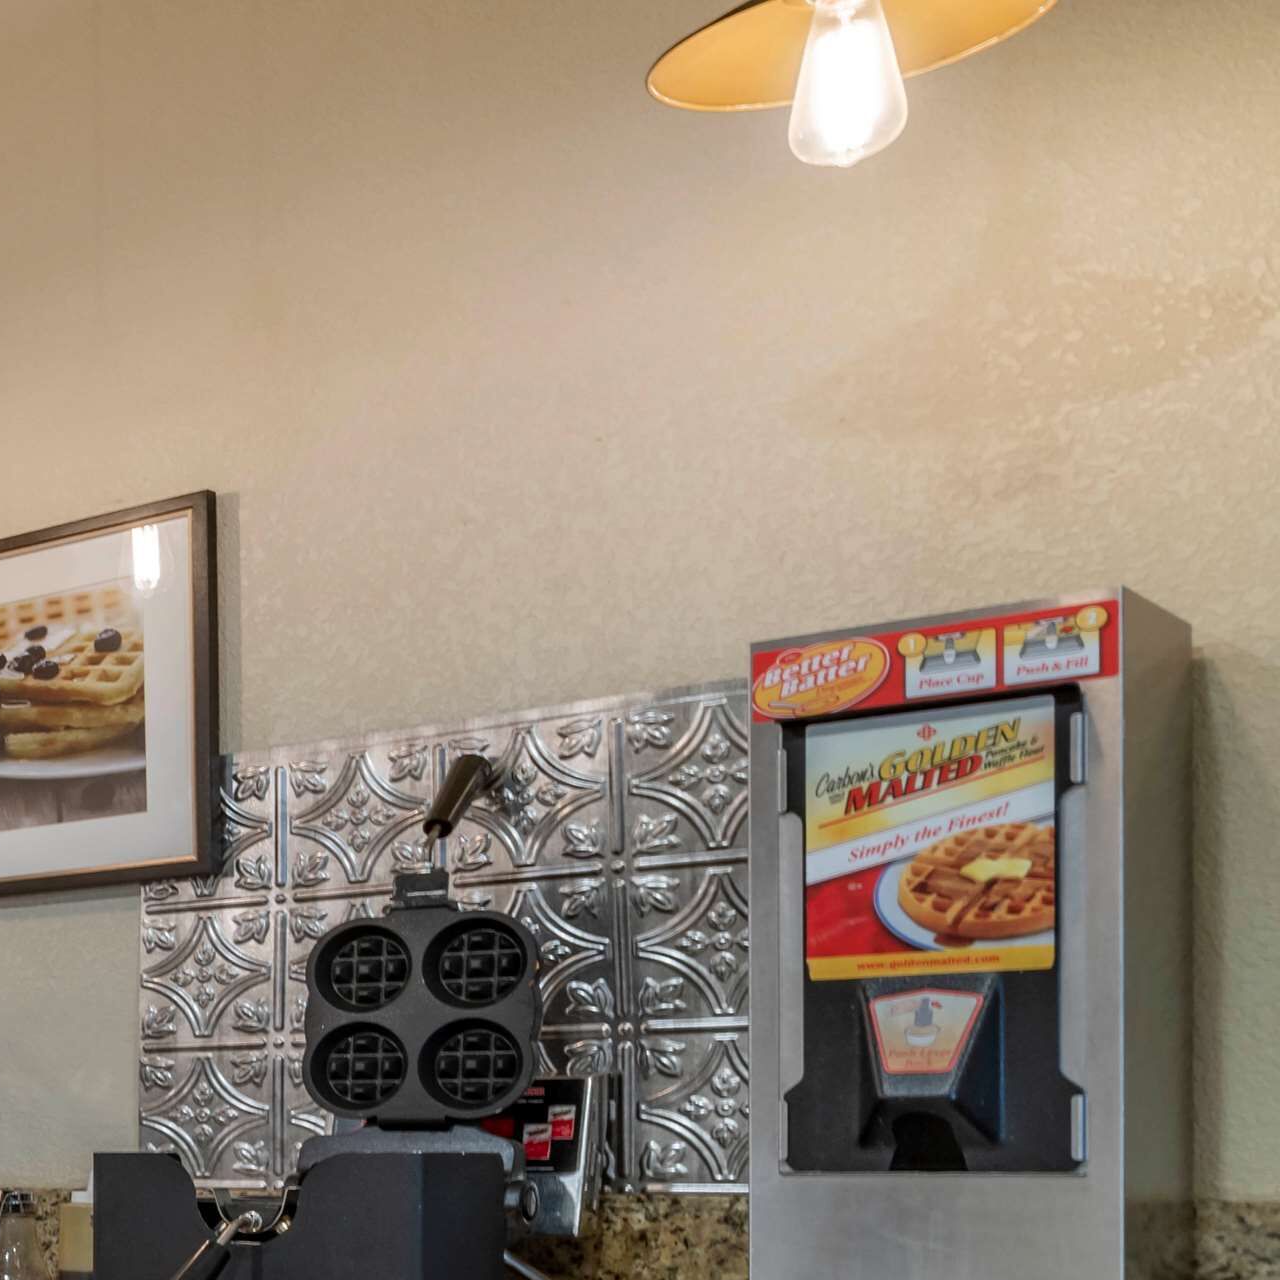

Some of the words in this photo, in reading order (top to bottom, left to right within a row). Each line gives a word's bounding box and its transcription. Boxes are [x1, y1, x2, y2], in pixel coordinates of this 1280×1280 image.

[763, 642, 855, 688] Better
[780, 652, 872, 699] Batter
[918, 676, 953, 690] Place
[957, 673, 984, 687] Cup
[1016, 661, 1050, 676] Push
[1051, 661, 1062, 672] &
[1065, 657, 1089, 671] Fill
[879, 716, 1021, 782] GOLDEN
[844, 754, 983, 816] MALTED
[848, 831, 910, 864] Simply
[914, 823, 942, 843] the
[946, 800, 1011, 833] Finest!
[856, 954, 1001, 971] www.goldenmalted.com
